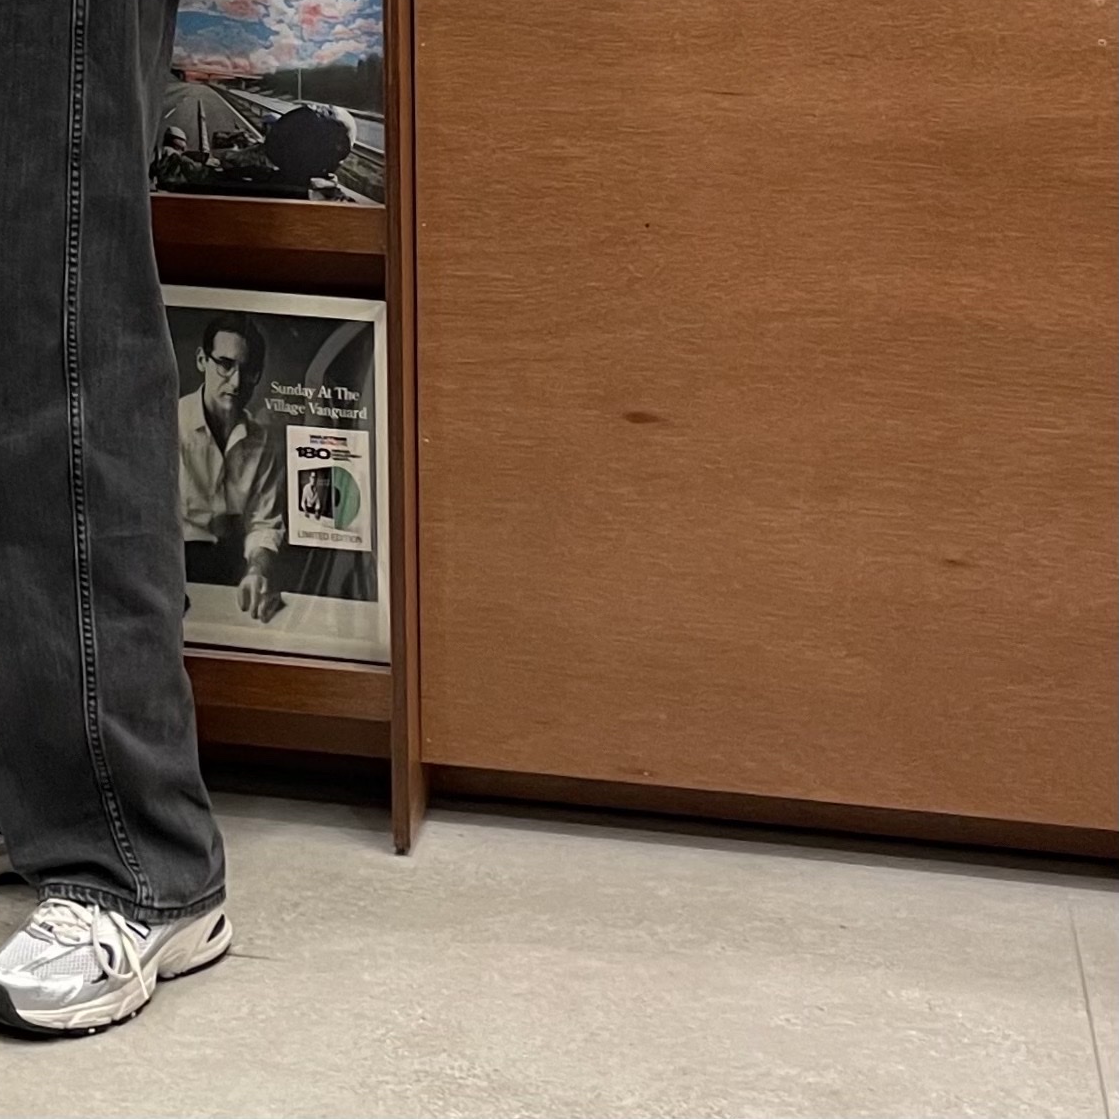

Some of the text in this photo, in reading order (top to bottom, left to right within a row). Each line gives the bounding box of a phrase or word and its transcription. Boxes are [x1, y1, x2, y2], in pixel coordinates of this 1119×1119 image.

[270, 381, 360, 402] Sunday At The
[264, 398, 368, 420] Village Vanguard
[296, 446, 331, 460] 180
